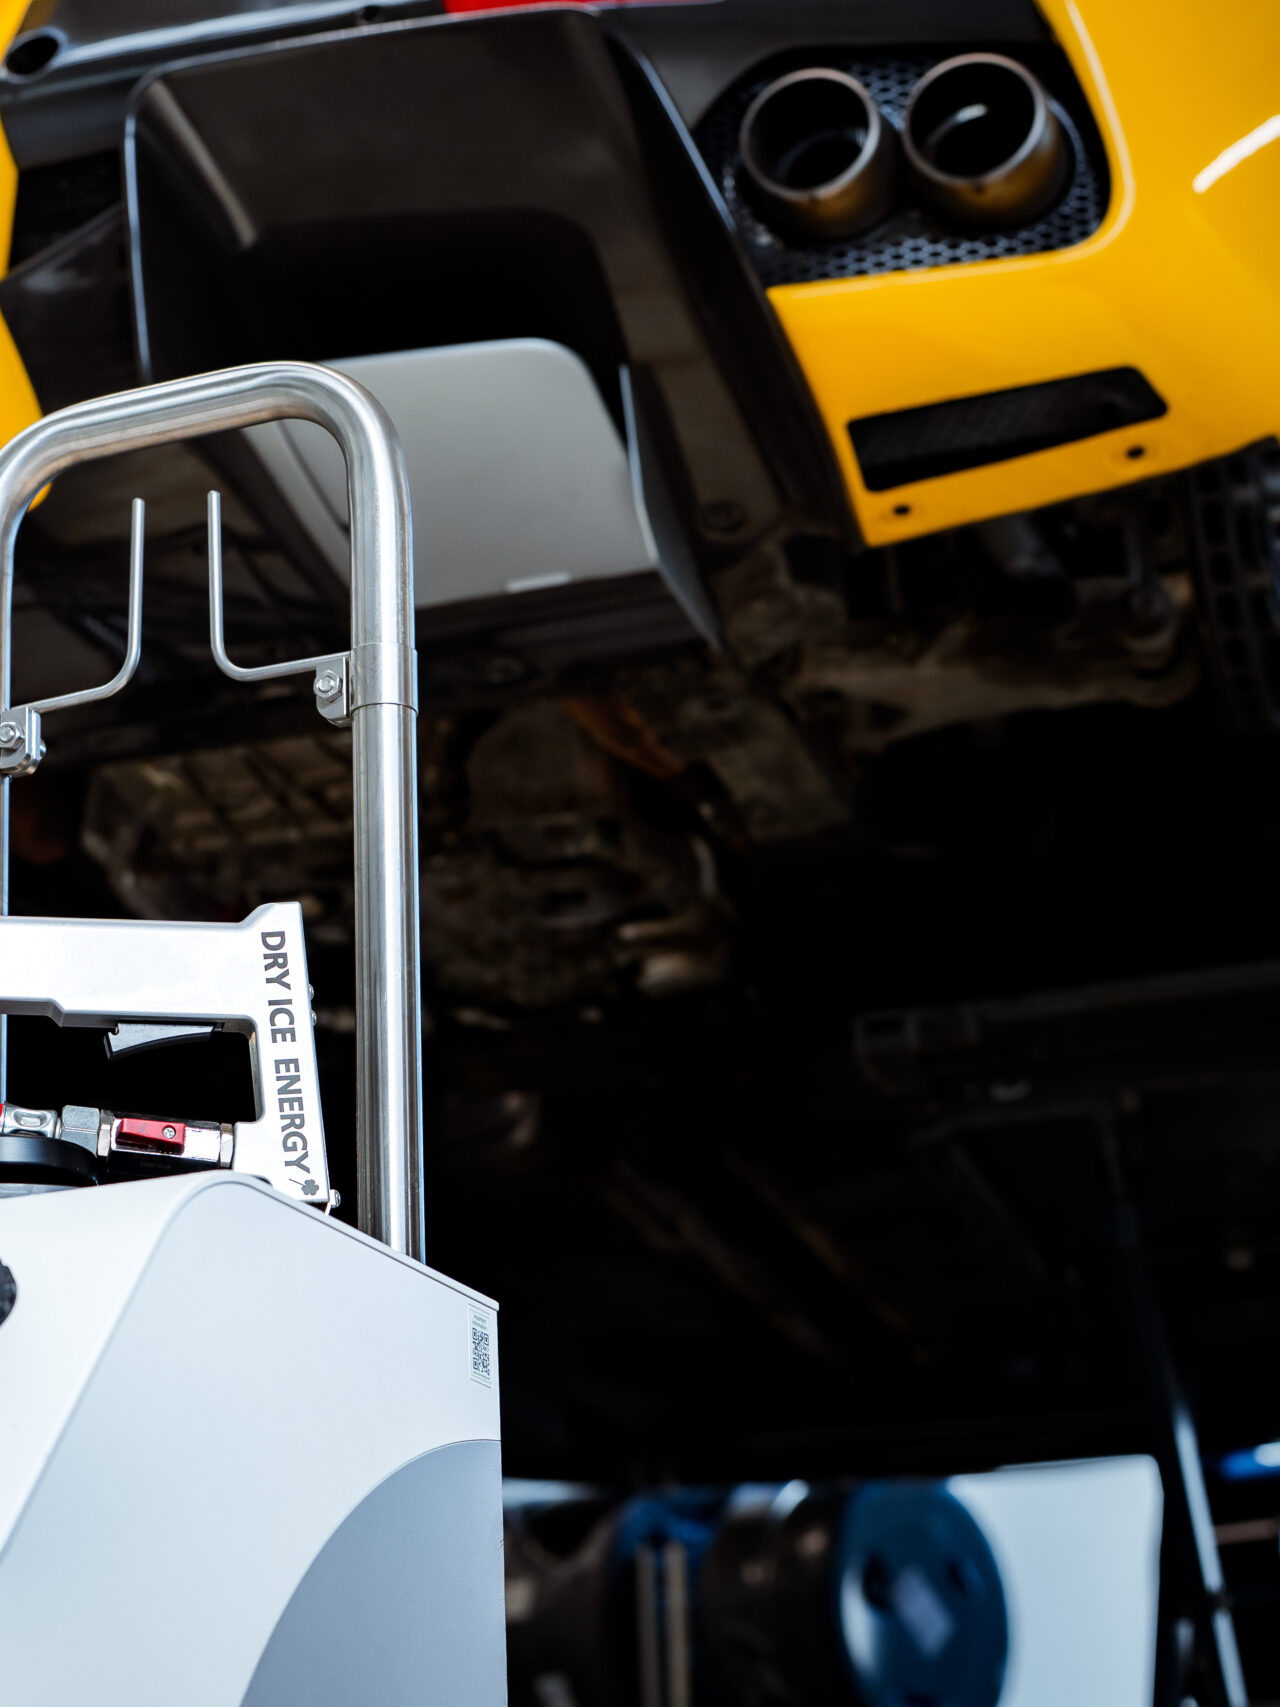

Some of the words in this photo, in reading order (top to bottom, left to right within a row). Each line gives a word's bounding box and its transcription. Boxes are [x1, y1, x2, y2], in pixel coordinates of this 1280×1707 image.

[261, 930, 292, 991] DRY
[267, 999, 297, 1044] ICE
[274, 1058, 311, 1174] ENERGY
